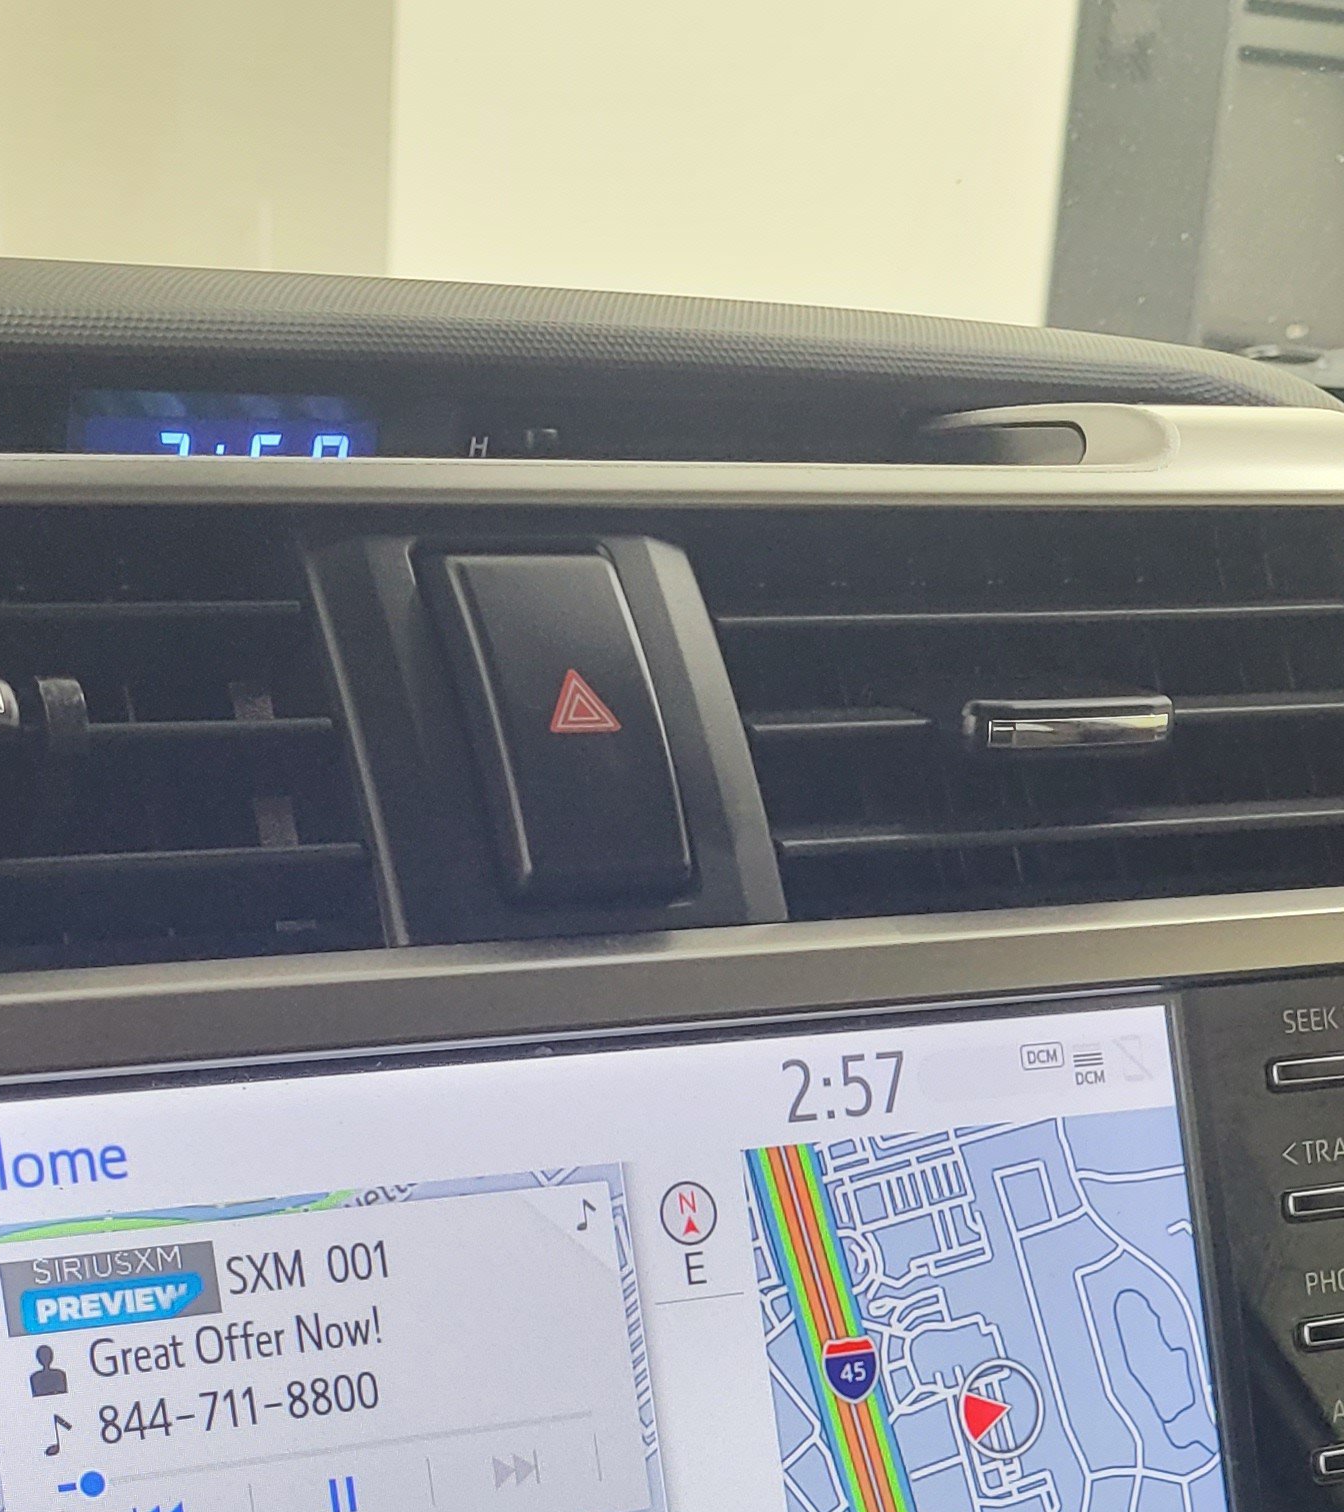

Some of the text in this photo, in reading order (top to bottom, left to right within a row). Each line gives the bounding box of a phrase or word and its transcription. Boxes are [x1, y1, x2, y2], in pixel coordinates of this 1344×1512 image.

[1025, 1046, 1059, 1066] DCM
[781, 1050, 905, 1125] 2:57
[1074, 1068, 1107, 1087] DCM
[32, 1245, 185, 1286] SIRIUSXM
[226, 1240, 391, 1296] SXM 001
[687, 1251, 708, 1286] E
[34, 1283, 189, 1326] PREVIEW
[88, 1305, 384, 1379] Great Offer Now!
[839, 1360, 868, 1384] 45
[98, 1371, 381, 1446] 844-711-8800
